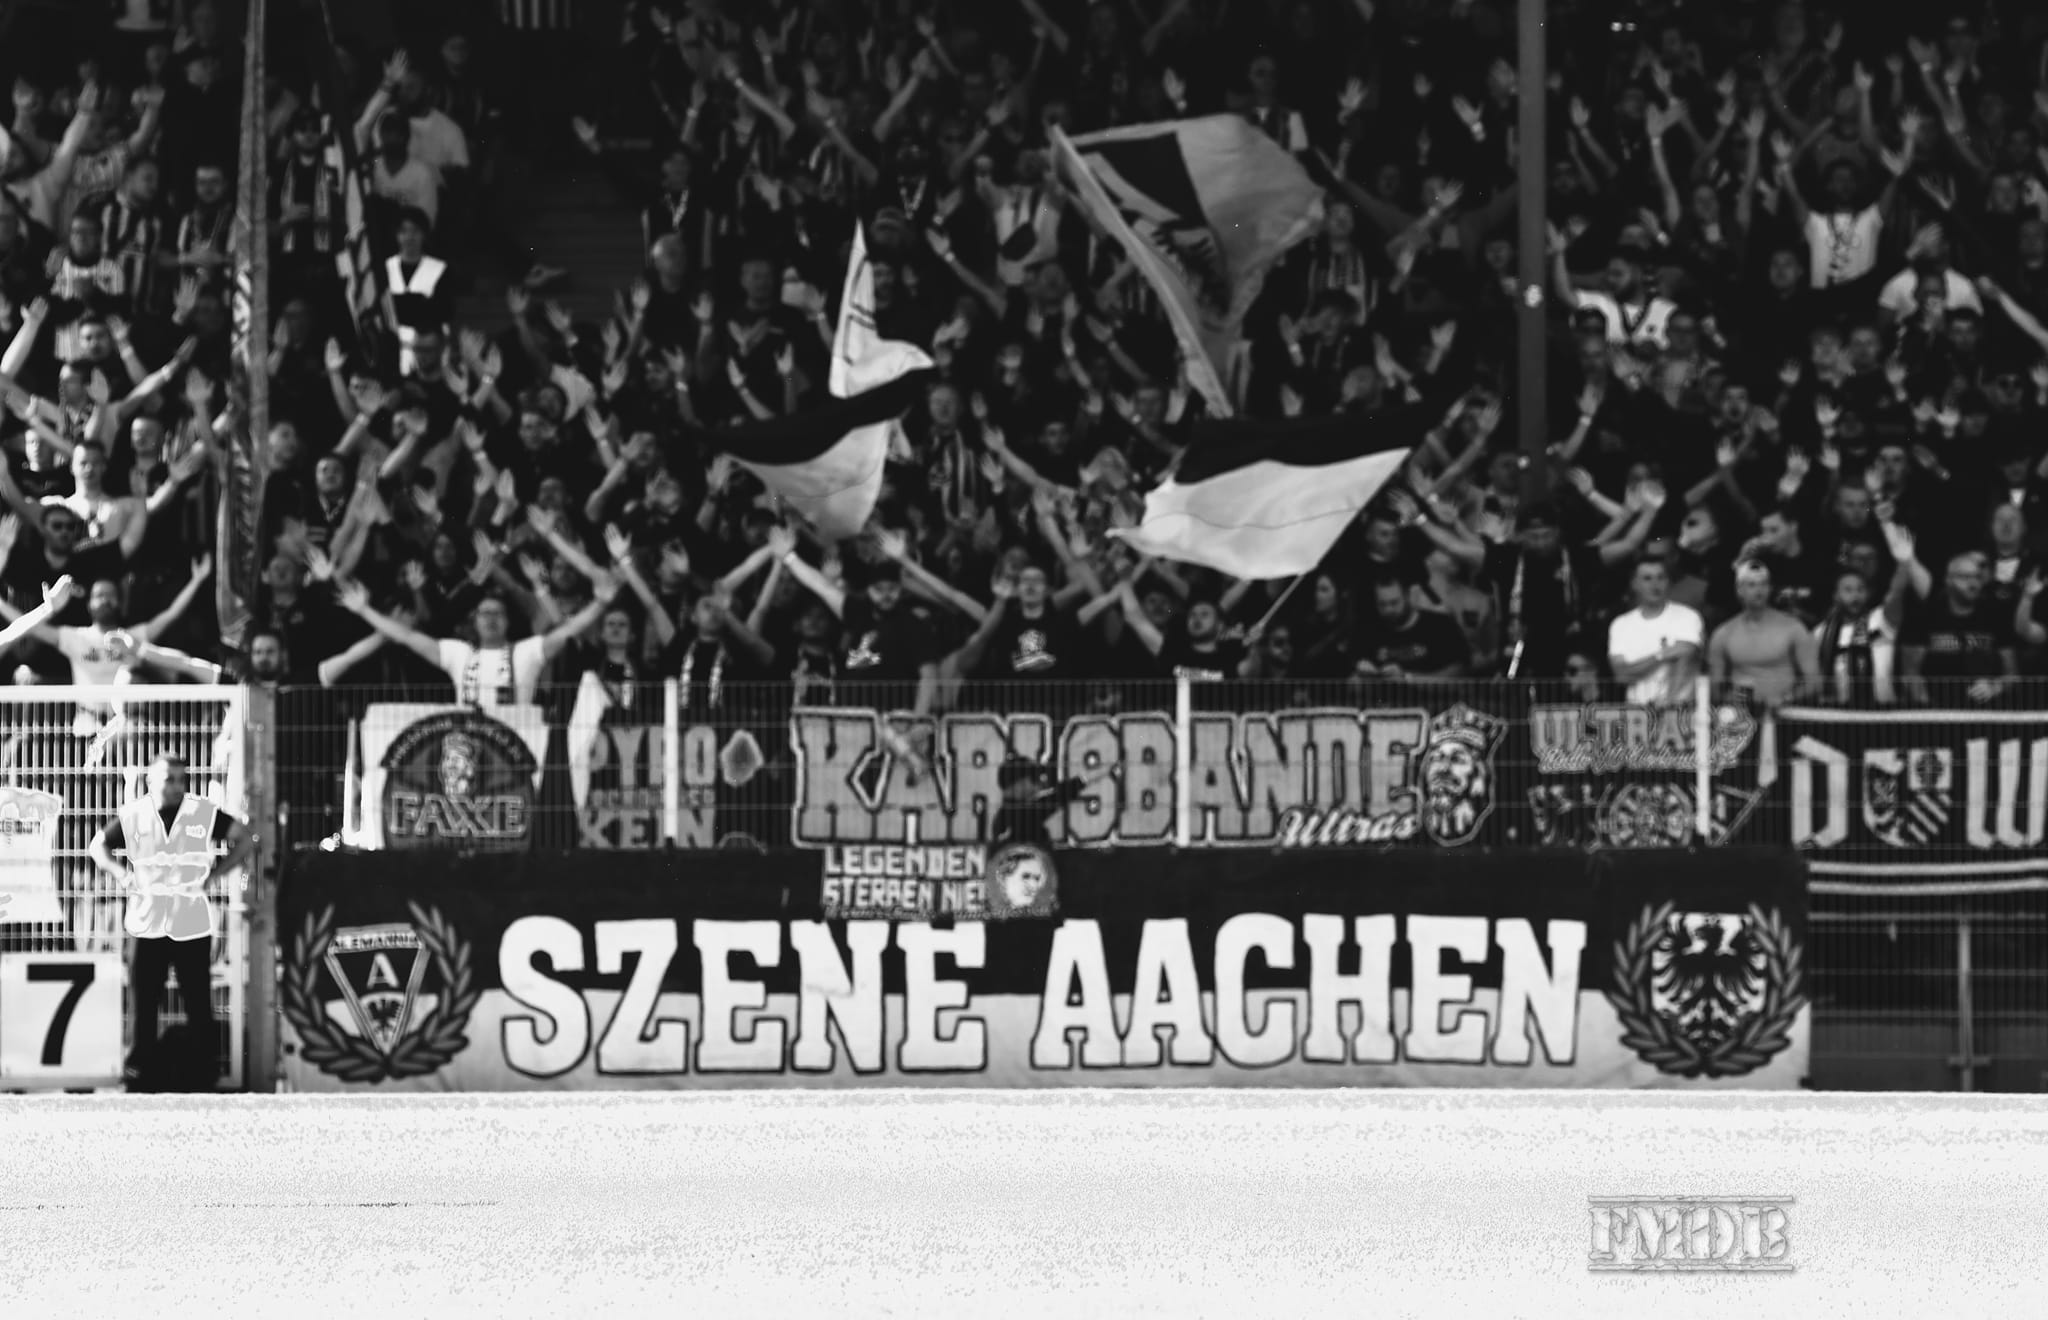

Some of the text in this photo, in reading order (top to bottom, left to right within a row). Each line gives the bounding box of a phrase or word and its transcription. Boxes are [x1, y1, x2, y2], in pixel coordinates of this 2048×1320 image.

[1530, 706, 1710, 752] ULTRA
[390, 791, 526, 838] FAXE
[1279, 810, 1417, 847] Ultras
[824, 845, 986, 877] LEGENDEN
[367, 952, 399, 990] A
[26, 962, 96, 1066] 7
[500, 913, 1587, 1077] SZENE AACHEN
